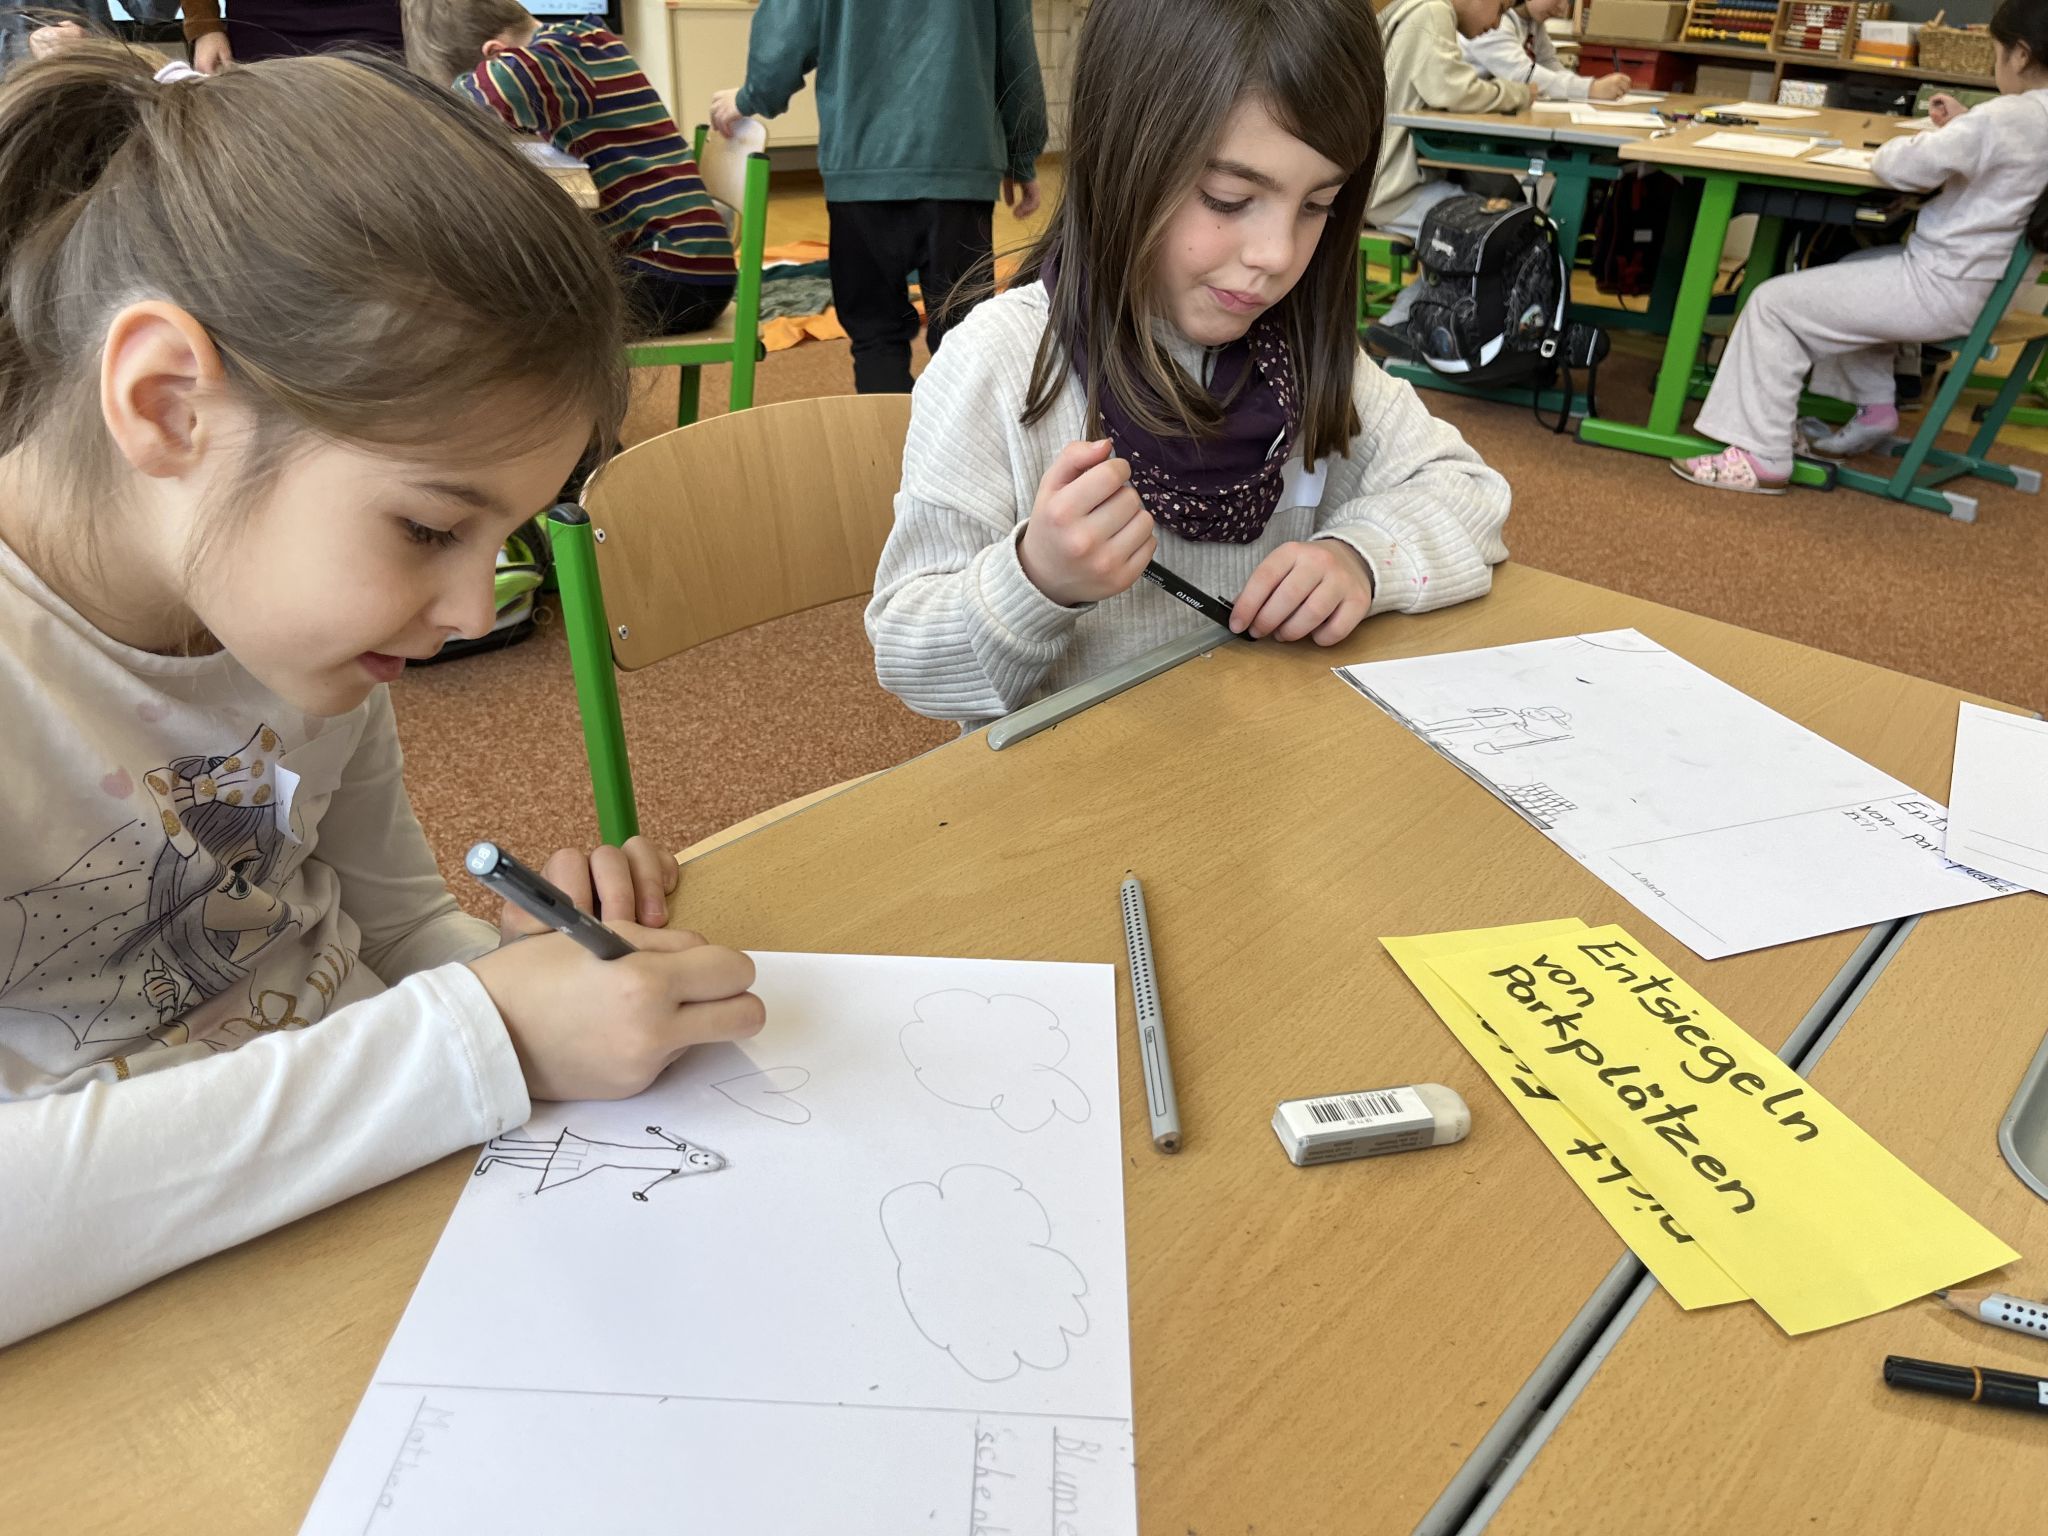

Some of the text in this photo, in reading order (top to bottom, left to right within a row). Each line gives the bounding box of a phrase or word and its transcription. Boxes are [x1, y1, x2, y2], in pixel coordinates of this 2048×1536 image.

[1176, 591, 1204, 609] ARISTO
[1860, 805, 1895, 826] von
[1532, 953, 1595, 1008] von
[1577, 940, 1819, 1142] Entsiegeln
[1488, 964, 1756, 1214] Parkplätzen
